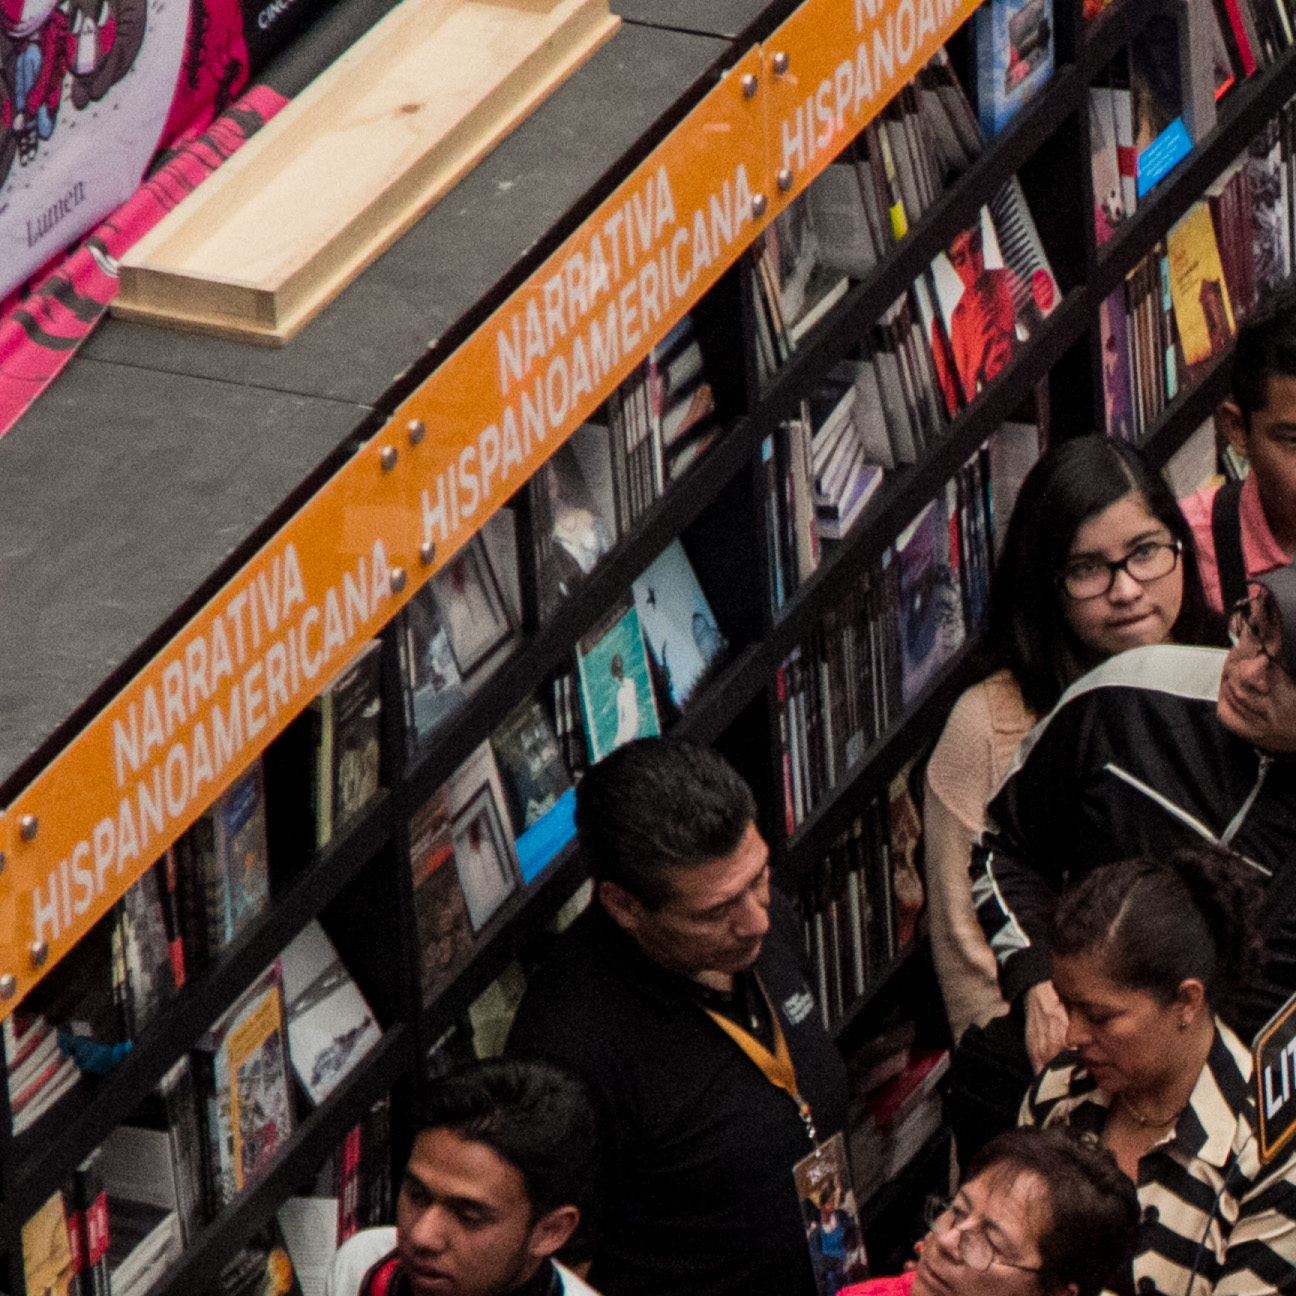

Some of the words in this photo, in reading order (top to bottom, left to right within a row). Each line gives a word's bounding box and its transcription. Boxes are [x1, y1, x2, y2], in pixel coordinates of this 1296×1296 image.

[25, 181, 87, 248] Lumen
[496, 166, 677, 395] NARRATIVA
[421, 163, 755, 546] HISPANOAMERICANA
[32, 539, 393, 949] HISPANOAMERICANA
[112, 543, 305, 786] NARRATIVA
